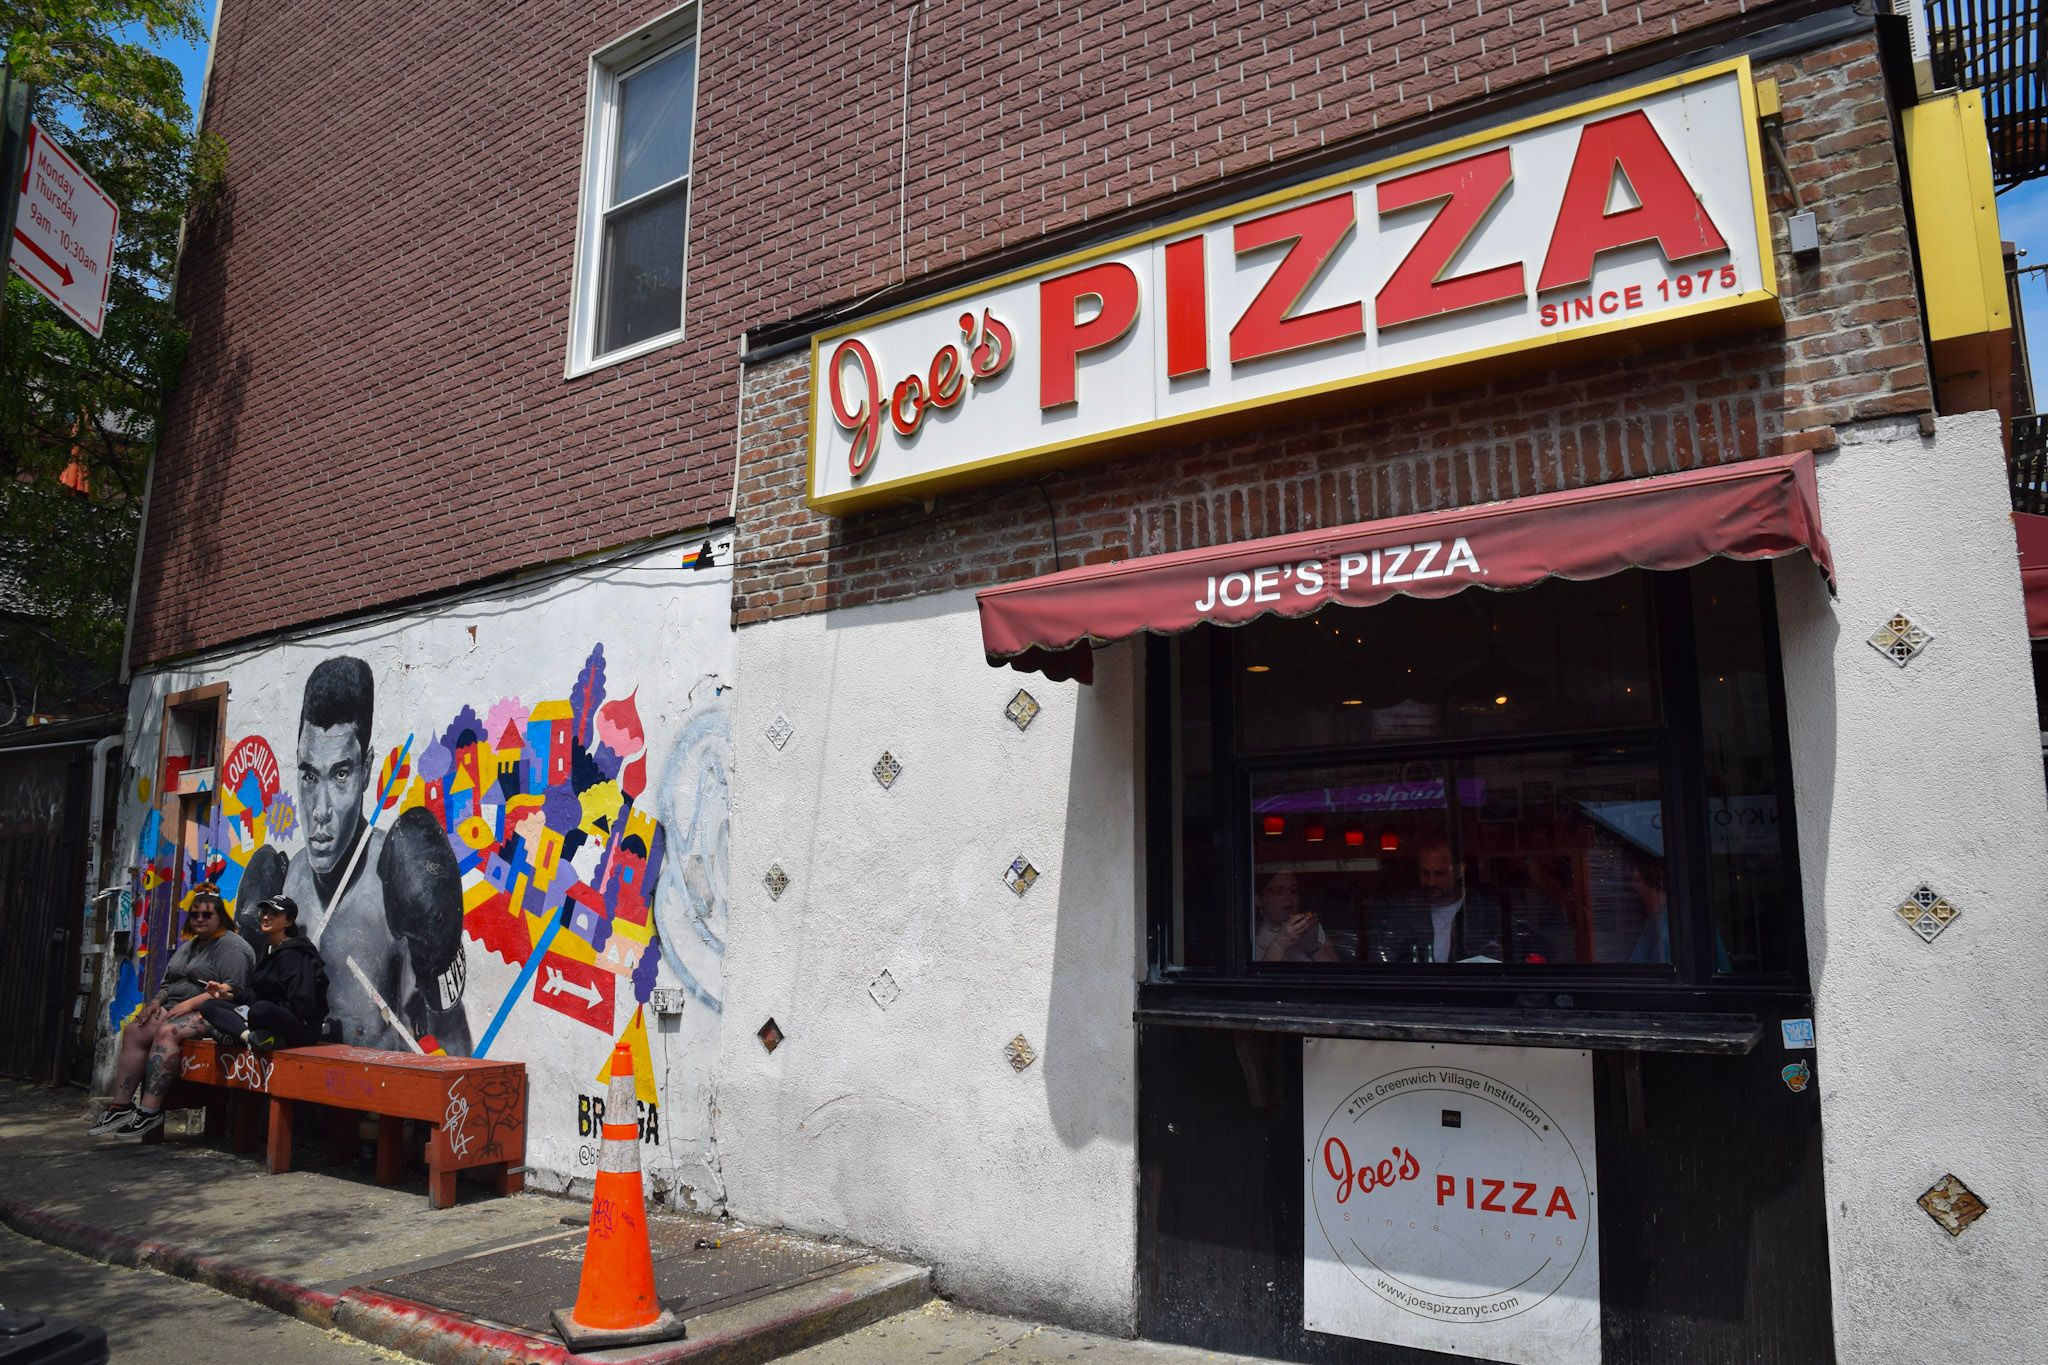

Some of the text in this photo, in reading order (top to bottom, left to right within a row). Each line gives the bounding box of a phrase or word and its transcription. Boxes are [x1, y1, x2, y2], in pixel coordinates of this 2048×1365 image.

[35, 173, 78, 227] Thursday
[37, 151, 75, 200] Monday
[30, 202, 51, 234] 9am
[59, 229, 98, 276] 10:30am
[829, 108, 1731, 478] Joe's PIZZA
[1540, 264, 1737, 326] SINCE 1975
[1195, 537, 1480, 612] JOE'S PIZZA
[222, 743, 278, 798] LOUISVILLE
[1352, 1091, 1374, 1110] The
[1375, 1072, 1436, 1096] Greenwich
[1439, 1072, 1480, 1089] Village
[1483, 1081, 1541, 1126] Institution
[1324, 1136, 1577, 1220] Joe's PIZZA
[1343, 1212, 1563, 1247] Since 1975
[1377, 1278, 1520, 1318] www.joespizzanyc.com
